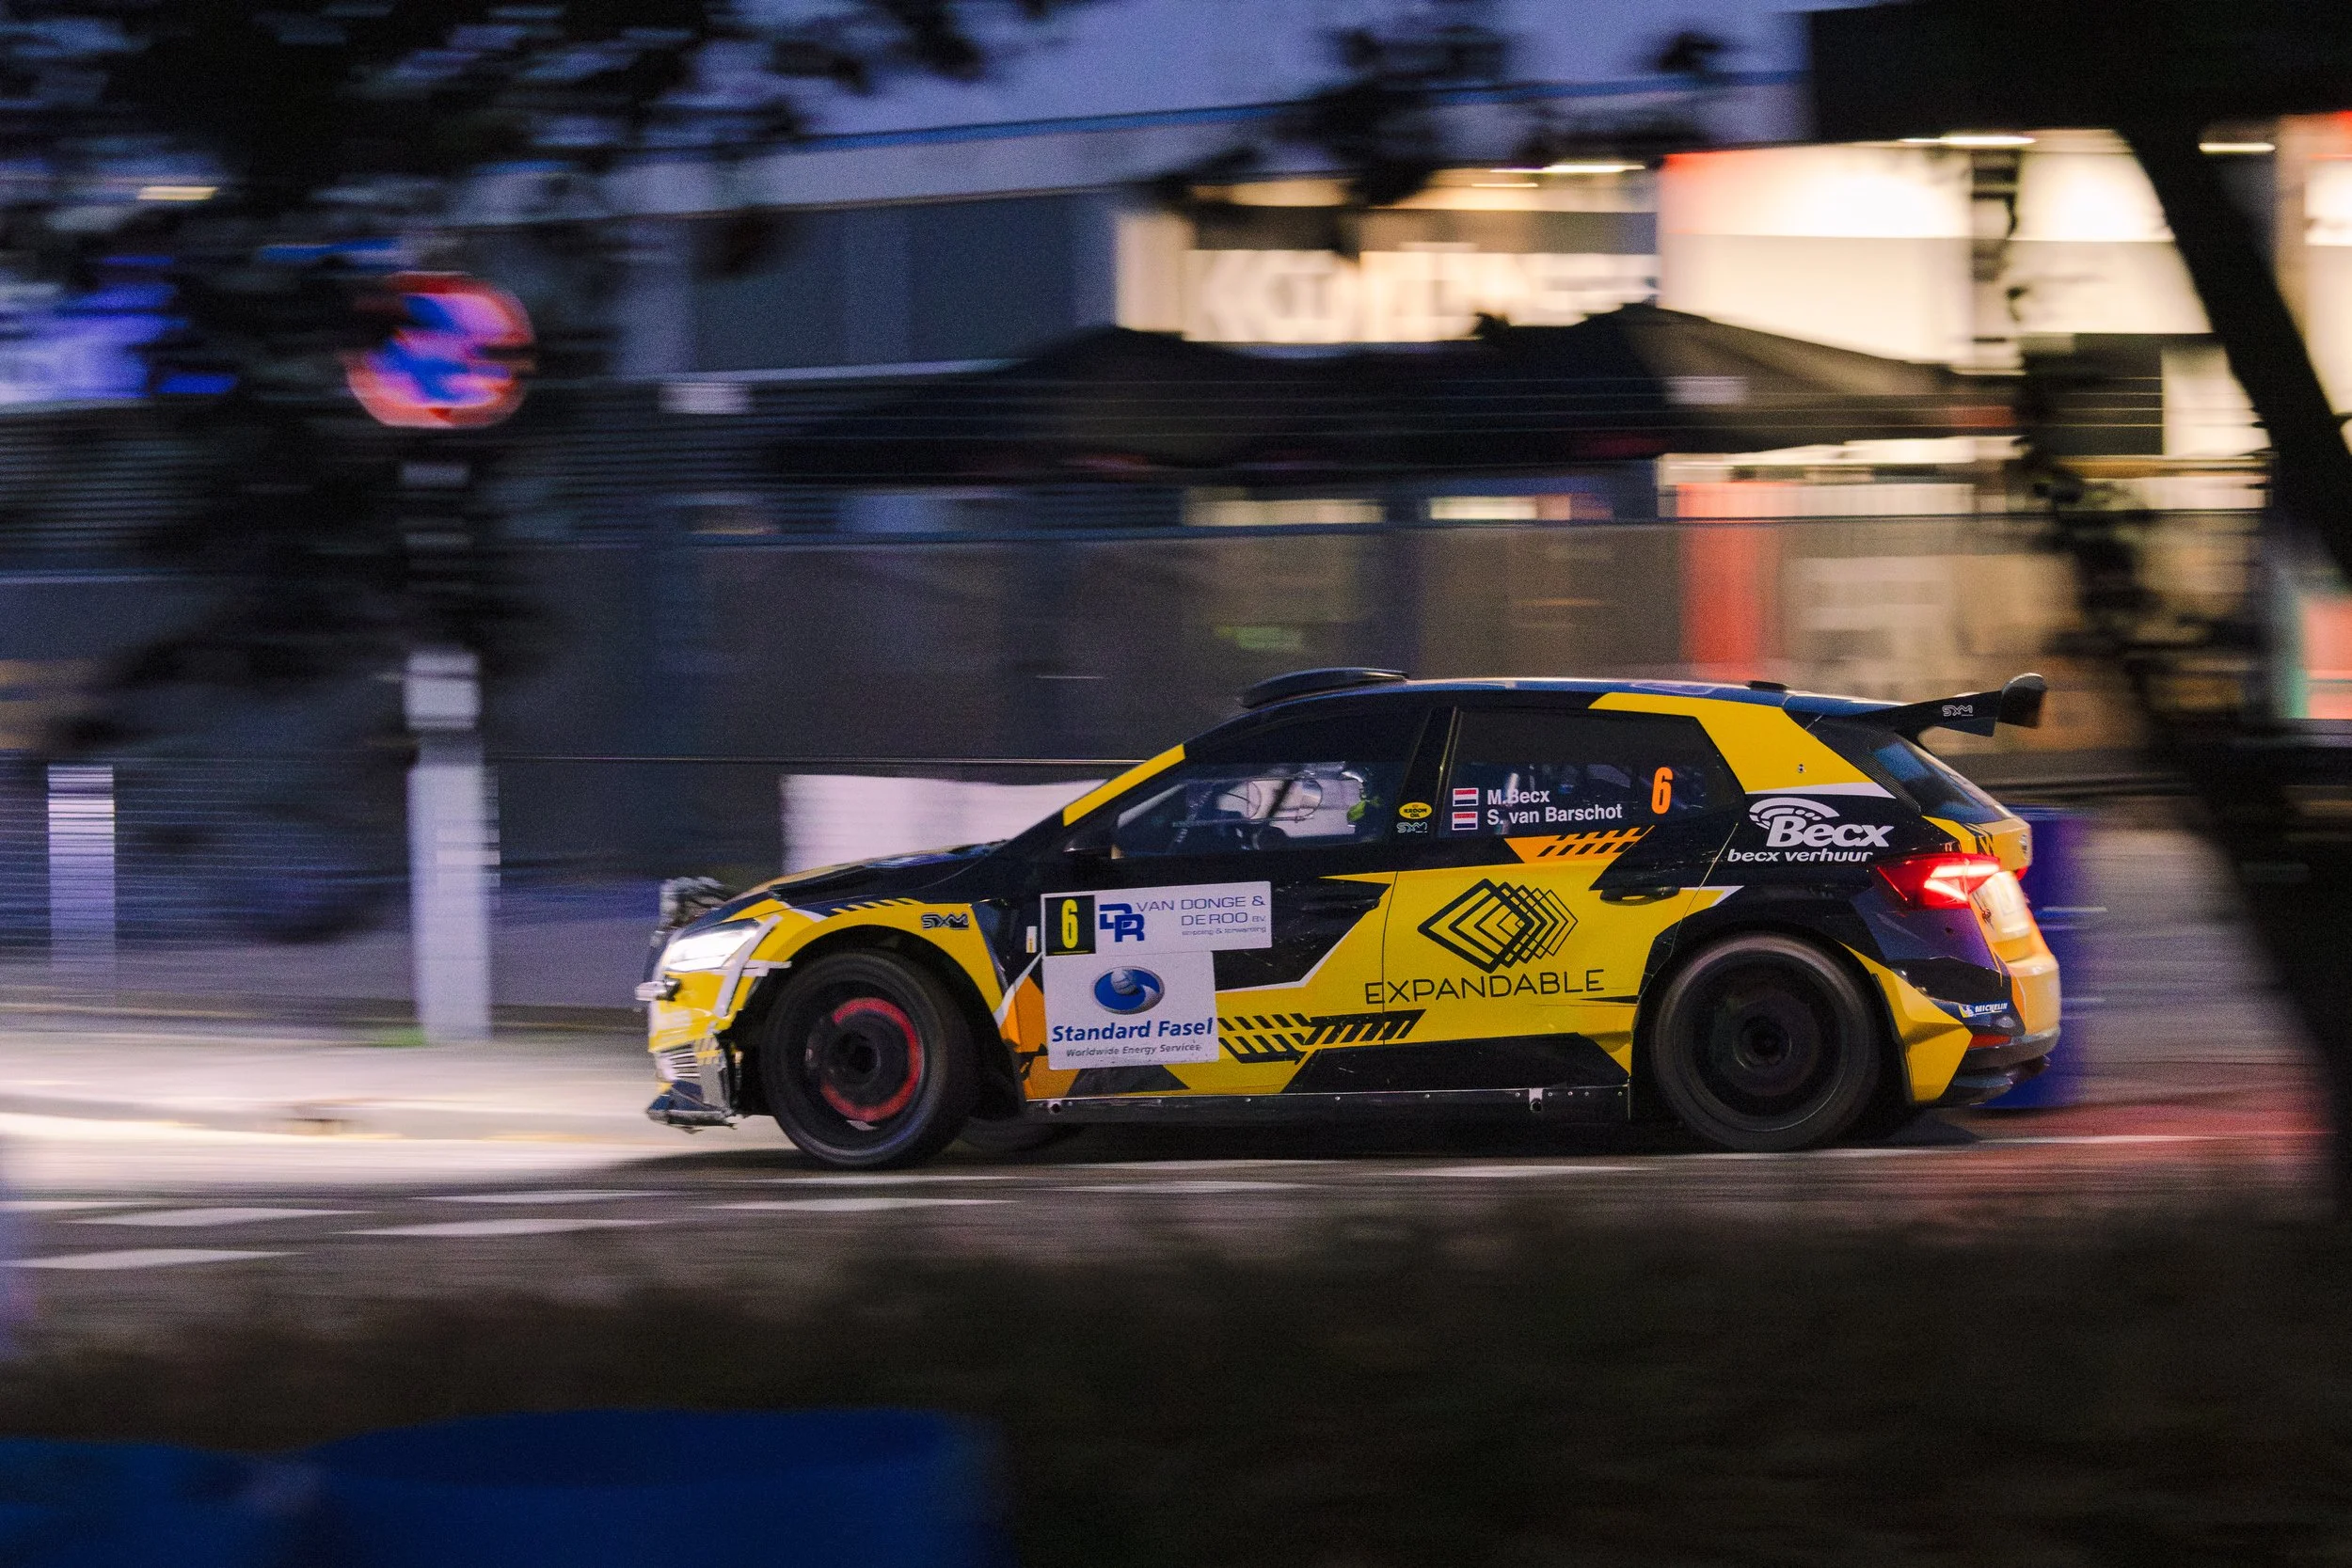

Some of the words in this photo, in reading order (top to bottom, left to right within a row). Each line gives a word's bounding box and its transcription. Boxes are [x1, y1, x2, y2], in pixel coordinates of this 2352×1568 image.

[1651, 767, 1673, 815] 6
[1486, 809, 1504, 825] S.
[1509, 811, 1540, 824] van
[1545, 804, 1623, 823] Barschot
[1766, 816, 1894, 847] Becx
[1727, 848, 1779, 862] becx
[1785, 848, 1873, 862] verhuur
[1136, 900, 1174, 911] VAN
[1181, 896, 1246, 910] DONGE
[1252, 895, 1265, 907] &
[1061, 899, 1078, 949] 6
[1365, 969, 1605, 1005] EXPANDABLE
[1976, 1003, 2008, 1013] MICHELIN
[1052, 1021, 1151, 1042] Standard
[1158, 1017, 1213, 1037] Fasel
[1066, 1047, 1120, 1057] Worldwide
[1122, 1044, 1156, 1055] Energy
